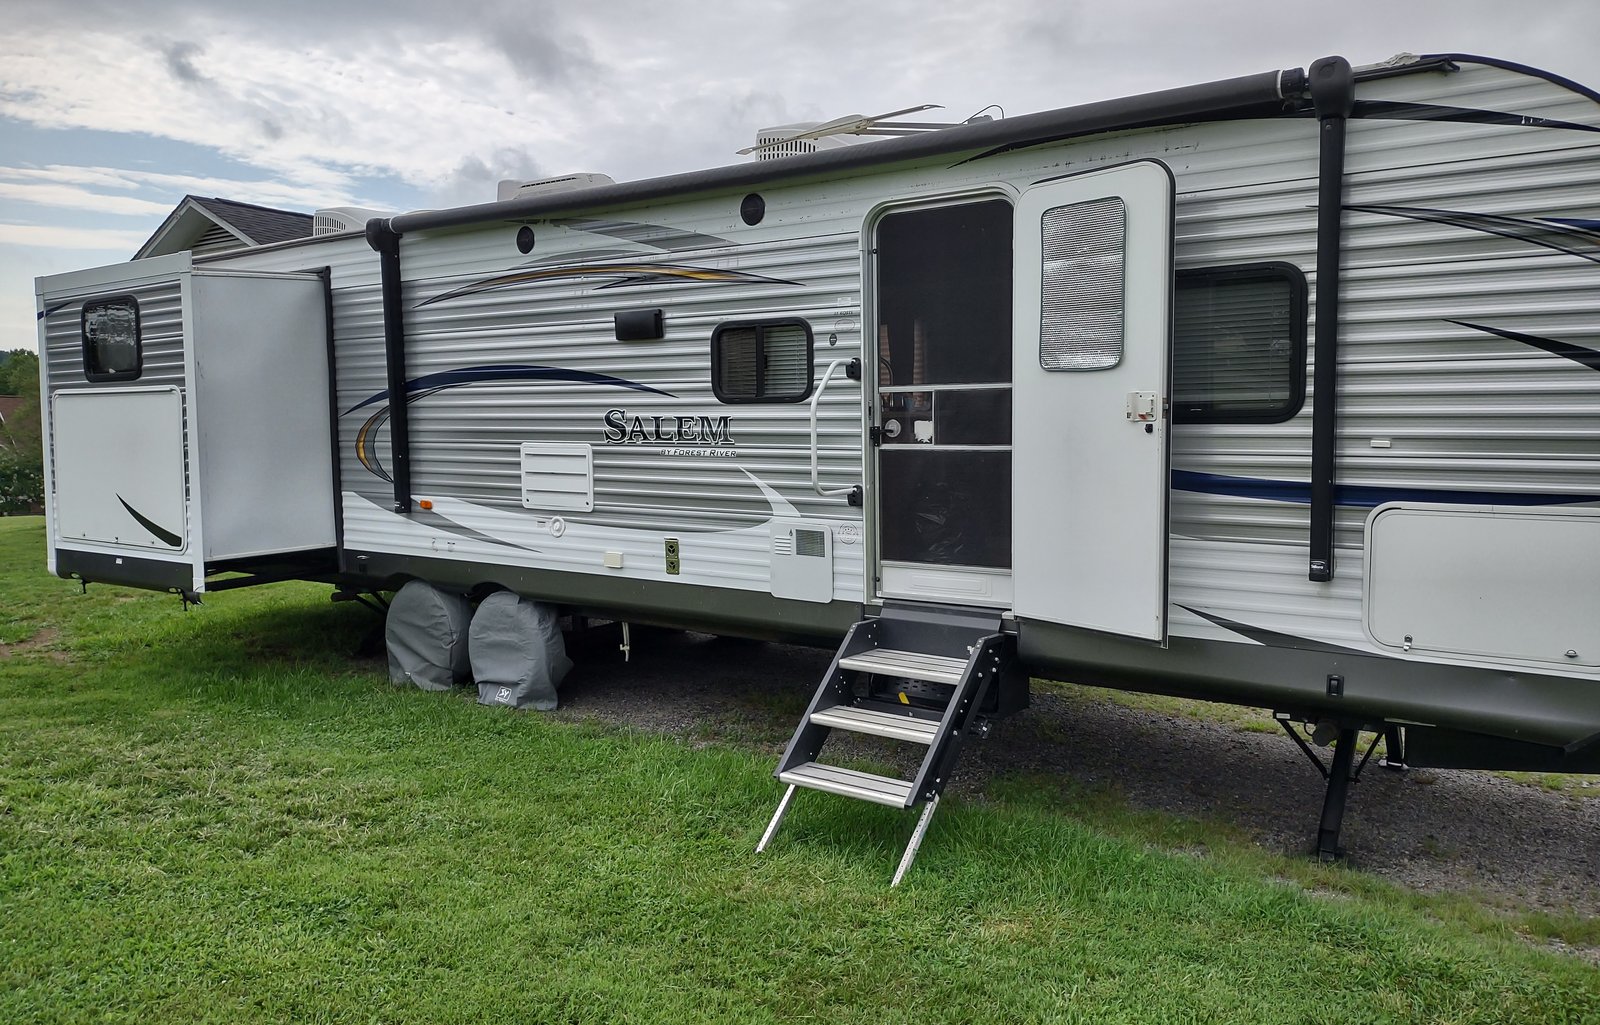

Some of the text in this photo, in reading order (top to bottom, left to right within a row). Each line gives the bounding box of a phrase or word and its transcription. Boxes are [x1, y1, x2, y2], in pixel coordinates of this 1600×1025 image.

[603, 408, 735, 445] SALEM
[673, 448, 707, 457] FOREST
[709, 449, 737, 457] RIVER
